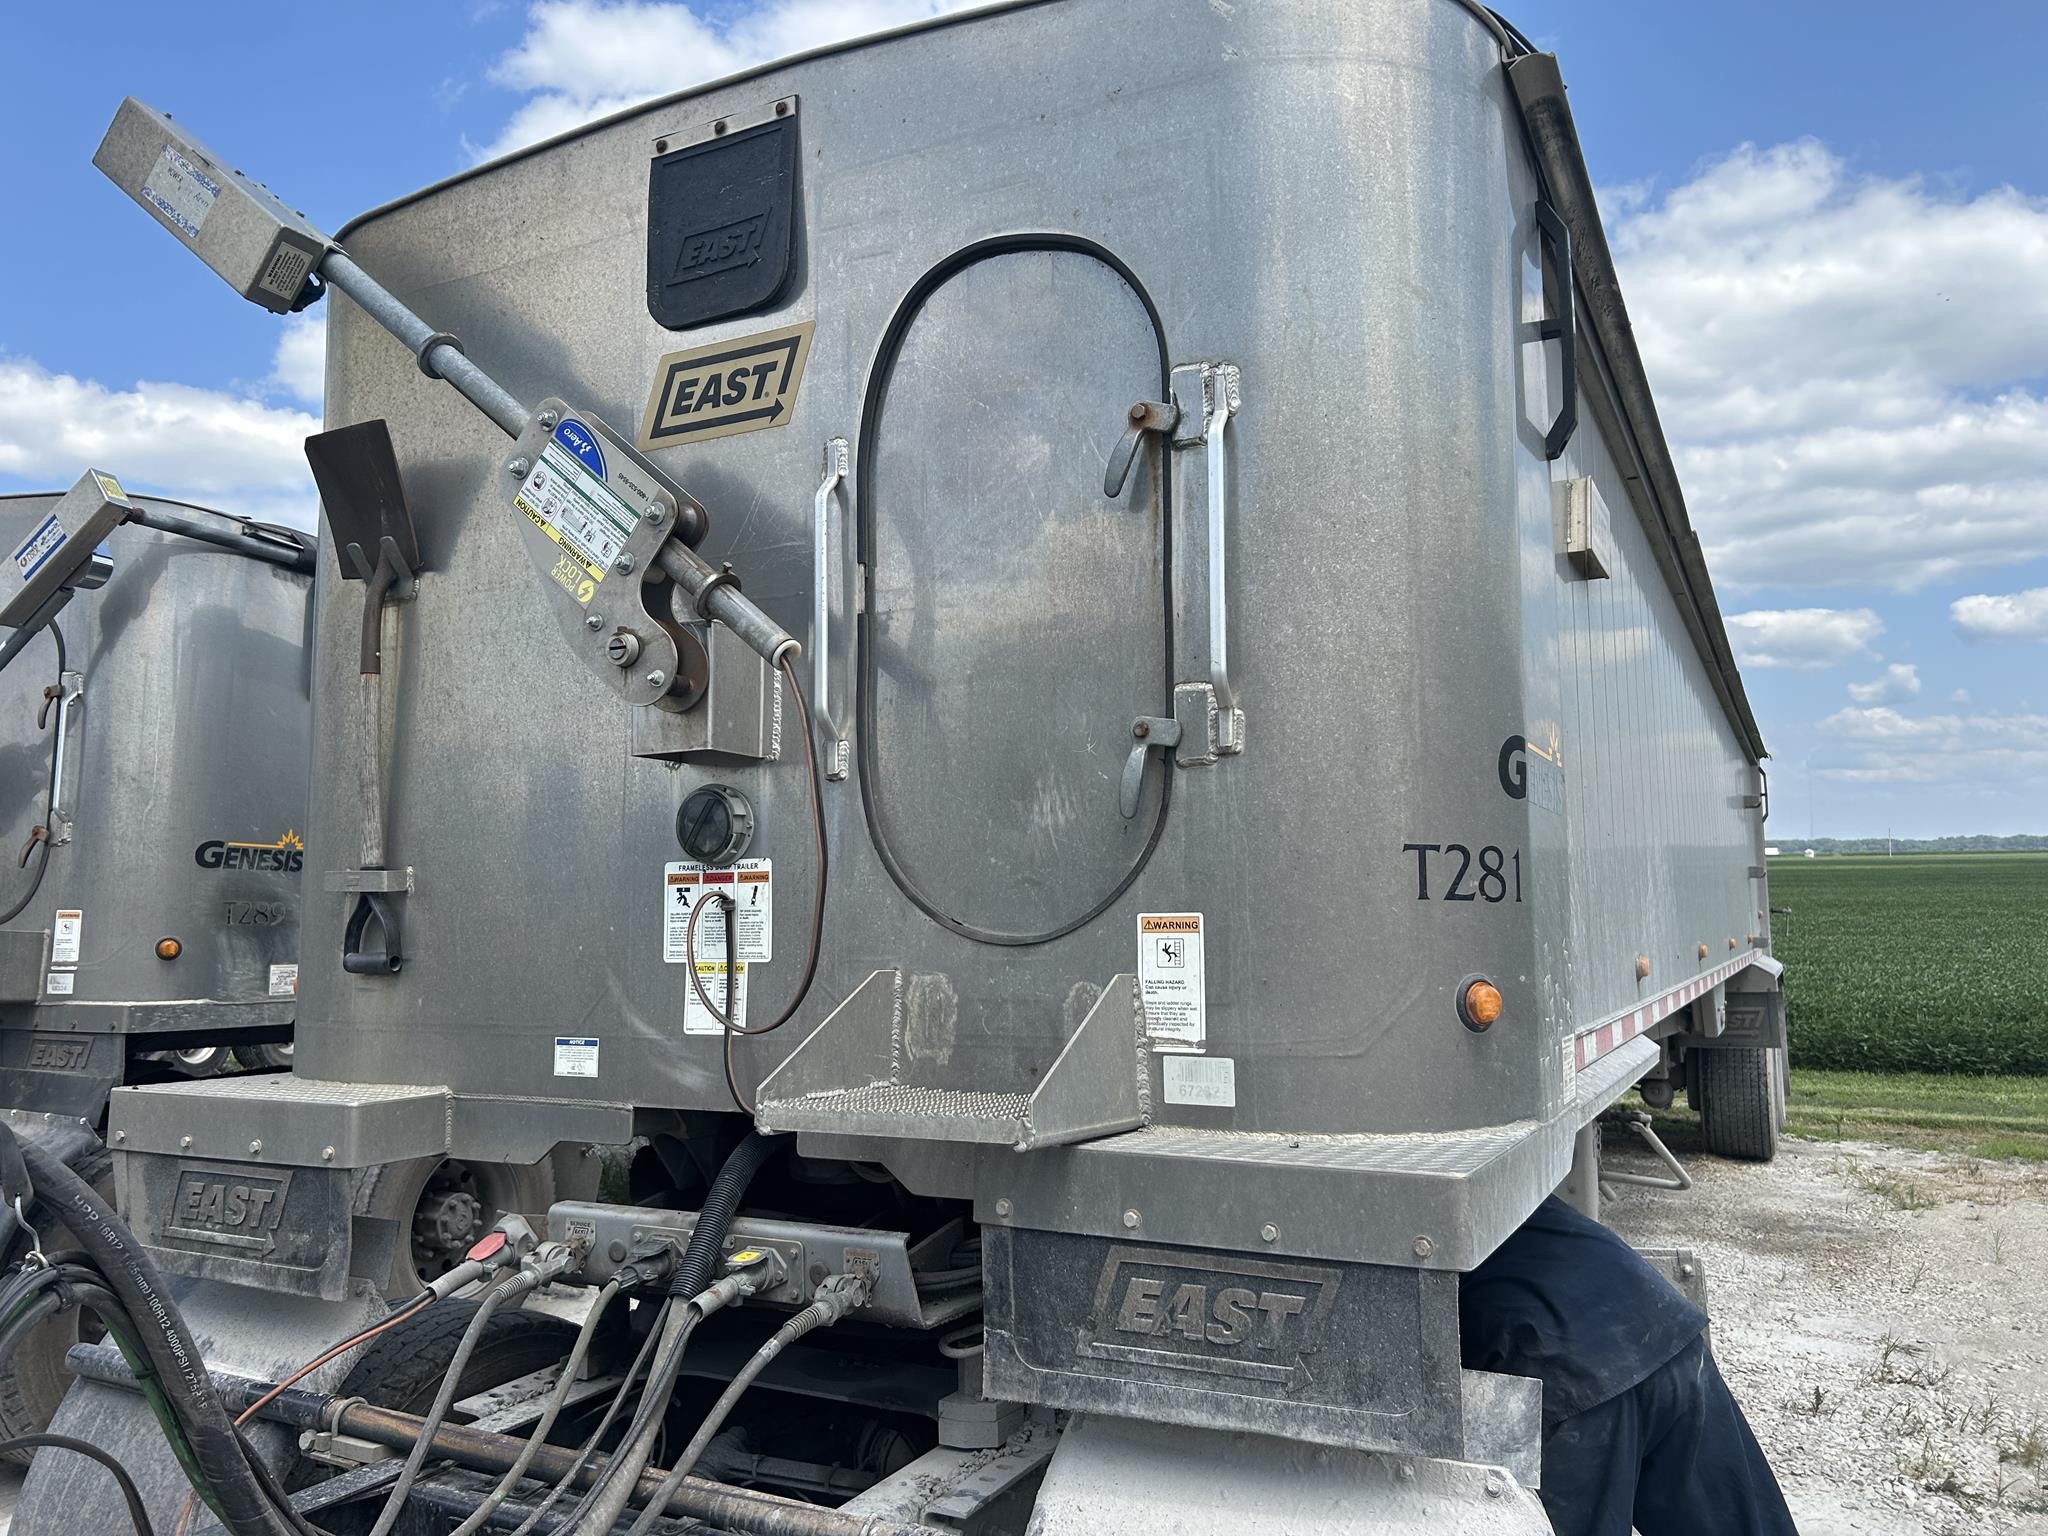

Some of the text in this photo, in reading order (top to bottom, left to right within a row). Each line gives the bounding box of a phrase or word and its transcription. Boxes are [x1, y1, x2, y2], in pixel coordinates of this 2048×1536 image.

[683, 222, 760, 270] EAST
[670, 360, 778, 416] EAST
[564, 428, 582, 447] Aero
[516, 500, 541, 524] CAUTION
[558, 538, 588, 564] WARNING
[550, 564, 575, 592] POWER
[554, 554, 582, 584] LOCK
[195, 840, 304, 872] GENESIS
[678, 864, 714, 872] FRAMELESS
[1402, 844, 1522, 902] T281
[1153, 921, 1199, 930] WARNING
[31, 1044, 85, 1069] EAST
[180, 1181, 276, 1228] EAST
[1114, 1276, 1306, 1350] EAST
[146, 1293, 171, 1330] 100R12
[166, 1329, 190, 1368] 4000PSI
